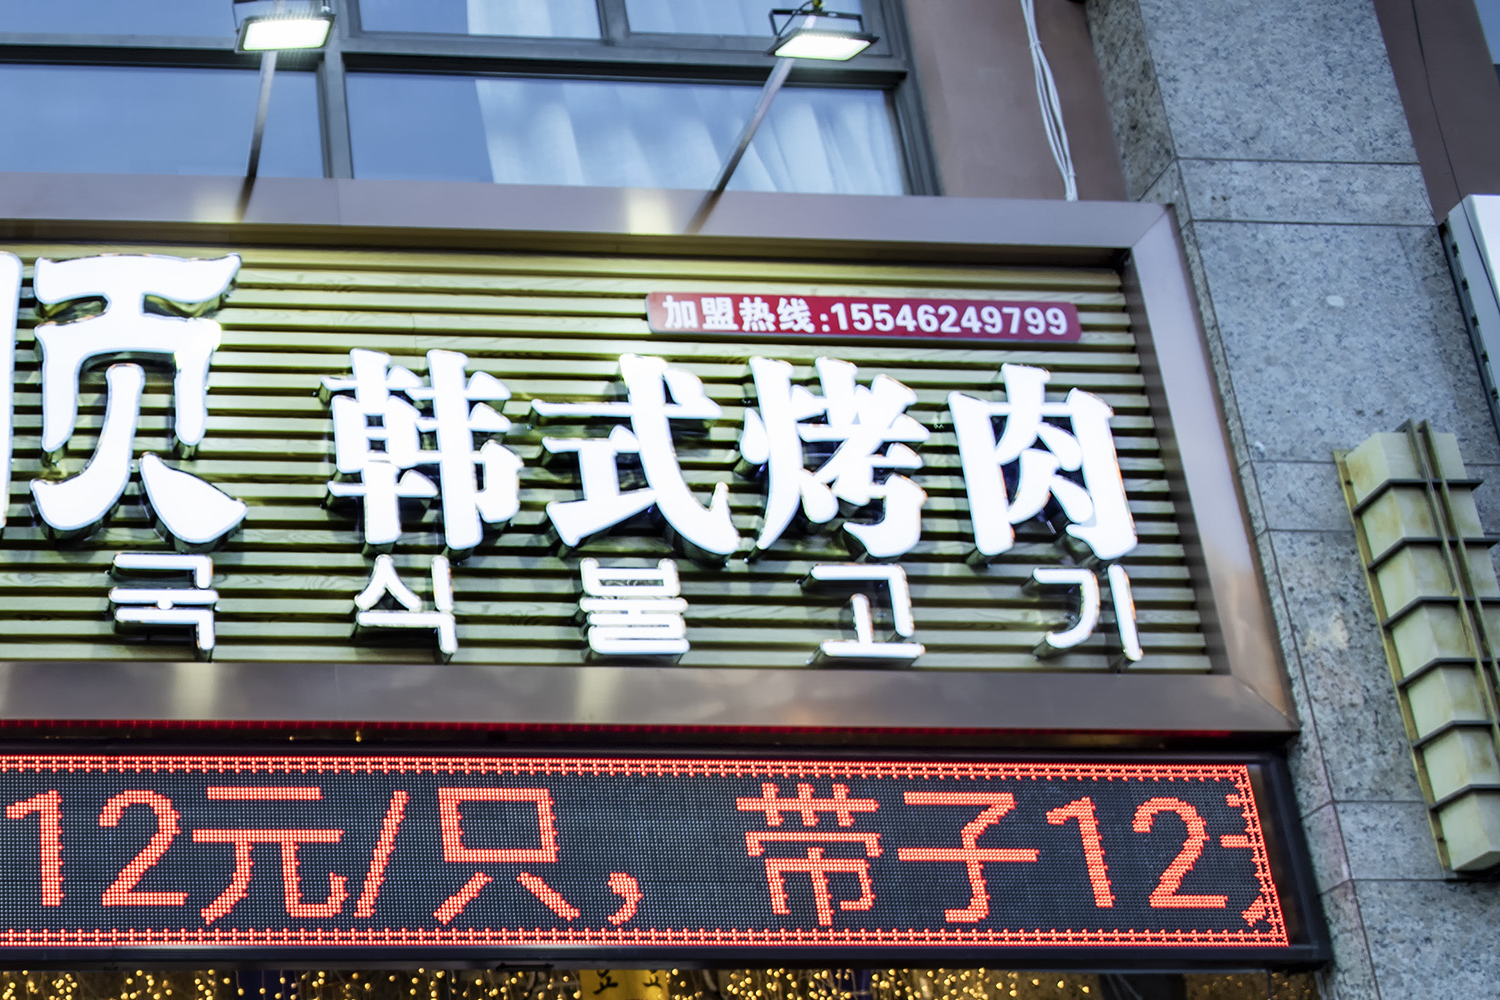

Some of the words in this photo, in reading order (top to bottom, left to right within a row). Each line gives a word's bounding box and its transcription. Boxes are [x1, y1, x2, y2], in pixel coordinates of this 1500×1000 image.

[662, 294, 1069, 336] 加盟热线:15546249799
[320, 347, 1139, 560] 韩式烤肉
